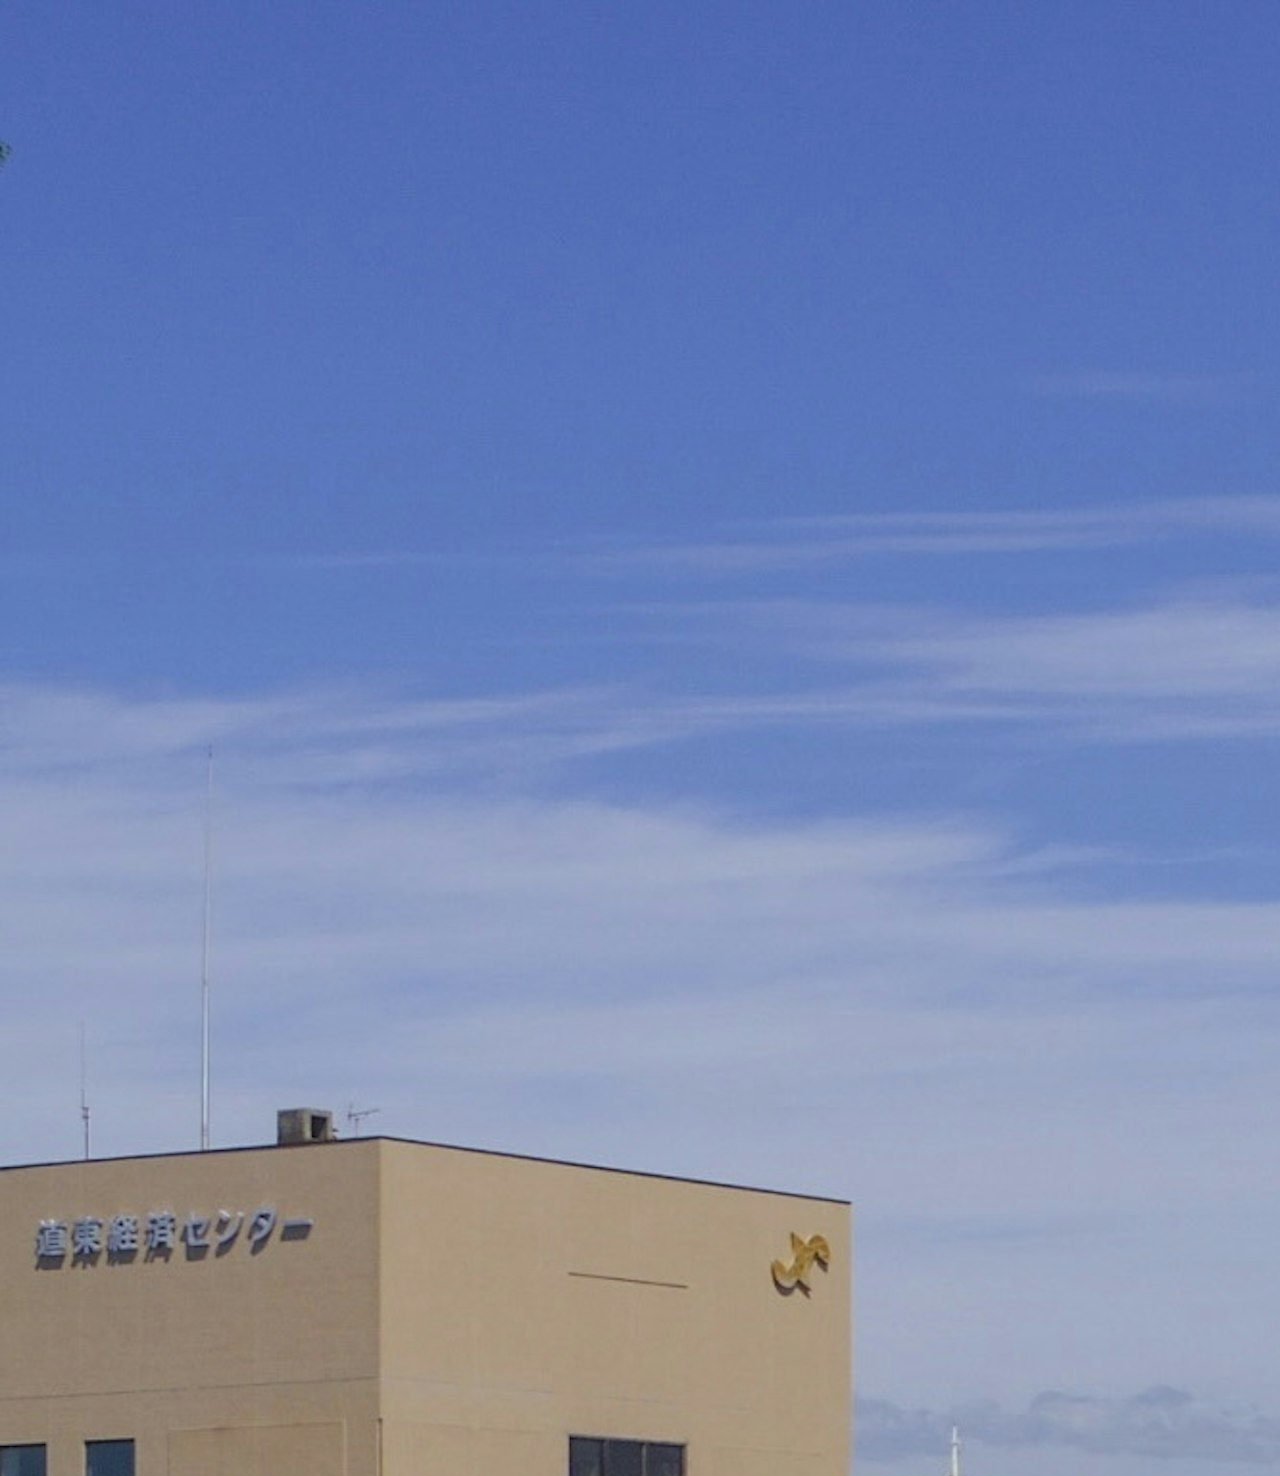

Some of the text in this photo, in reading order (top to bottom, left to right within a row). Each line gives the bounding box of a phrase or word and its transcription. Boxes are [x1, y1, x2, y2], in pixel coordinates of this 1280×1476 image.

[36, 1204, 314, 1257] 道東経済センター
